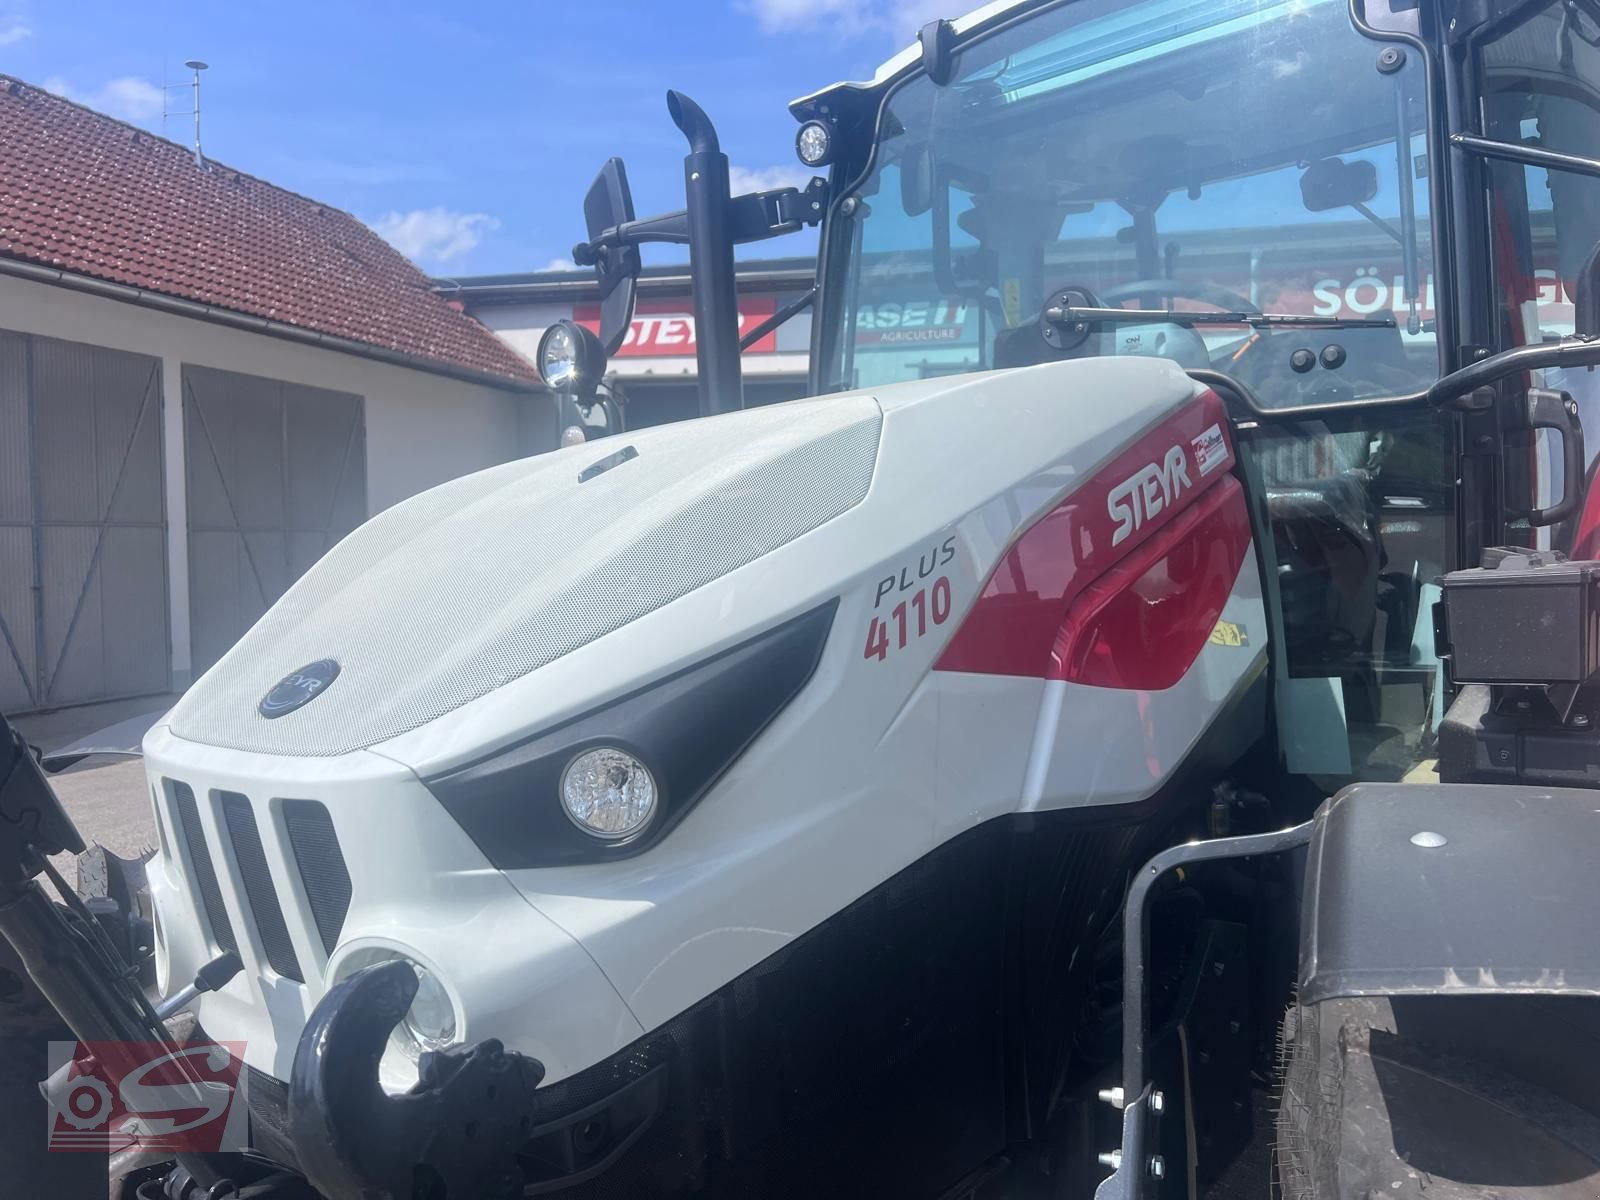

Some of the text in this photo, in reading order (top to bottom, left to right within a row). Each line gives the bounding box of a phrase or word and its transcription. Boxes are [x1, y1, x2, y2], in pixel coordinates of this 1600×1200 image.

[855, 302, 930, 329] ASE
[879, 328, 956, 342] AGRICULTURE
[1107, 444, 1193, 547] STEYR
[874, 536, 956, 608] PLUS
[863, 575, 952, 662] 4110
